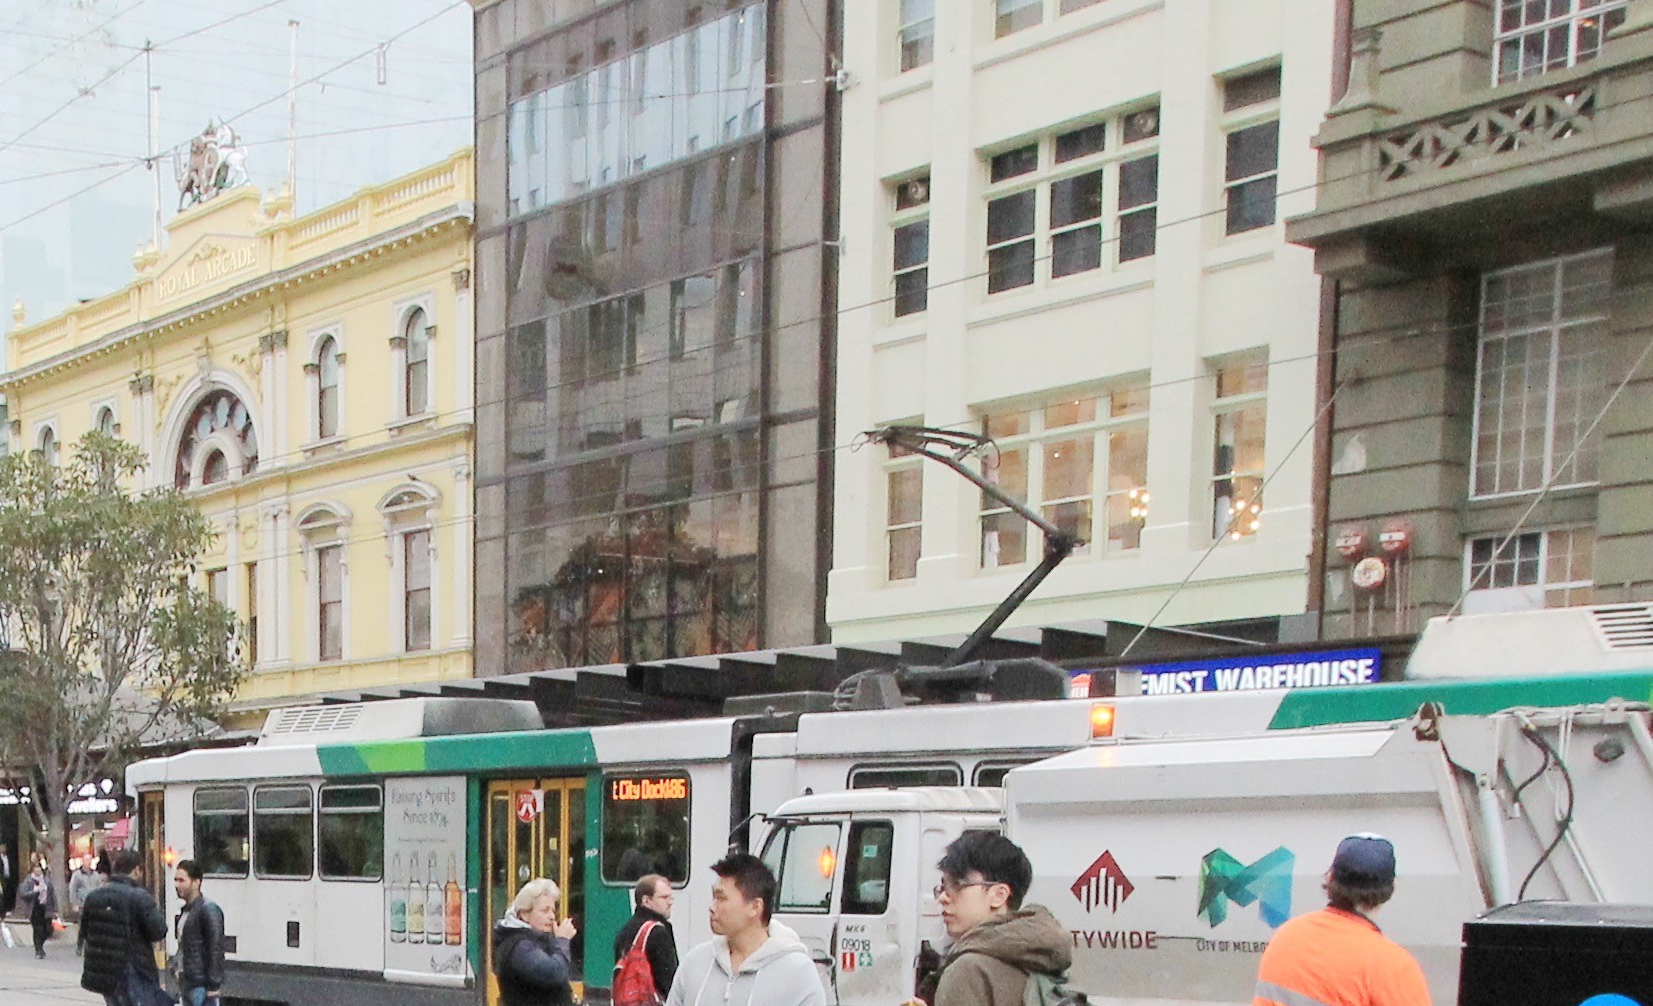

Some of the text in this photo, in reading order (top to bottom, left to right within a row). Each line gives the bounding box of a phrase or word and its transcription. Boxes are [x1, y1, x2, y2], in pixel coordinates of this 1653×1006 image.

[159, 244, 256, 298] ROYAL ARCADE
[1215, 658, 1374, 691] WAREHOUSE
[1071, 930, 1158, 949] TYWIDE
[1233, 941, 1269, 953] MELBO
